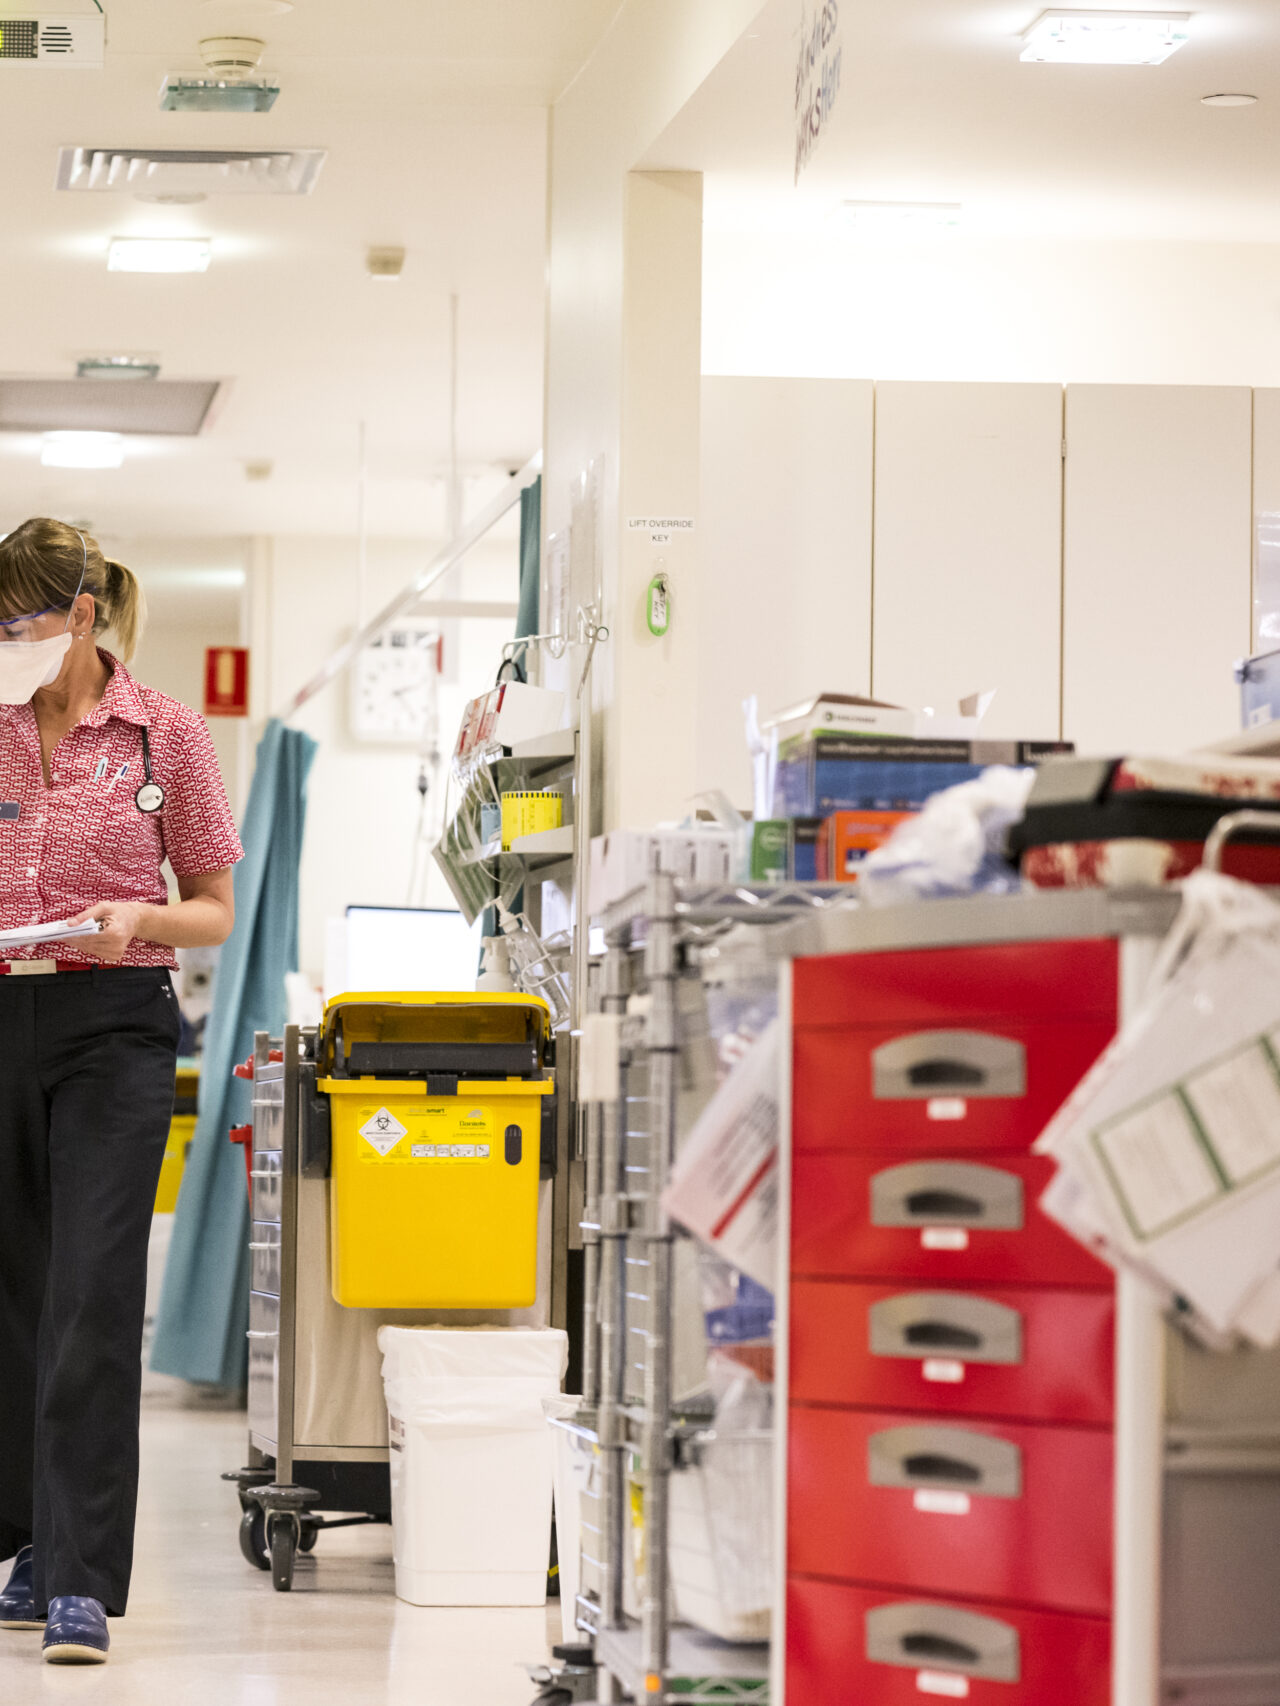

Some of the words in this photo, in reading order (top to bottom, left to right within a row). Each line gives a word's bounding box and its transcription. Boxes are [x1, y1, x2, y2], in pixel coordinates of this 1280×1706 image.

[629, 519, 647, 528] LIFT
[649, 519, 693, 528] OVERRIDE
[651, 534, 669, 542] KEY
